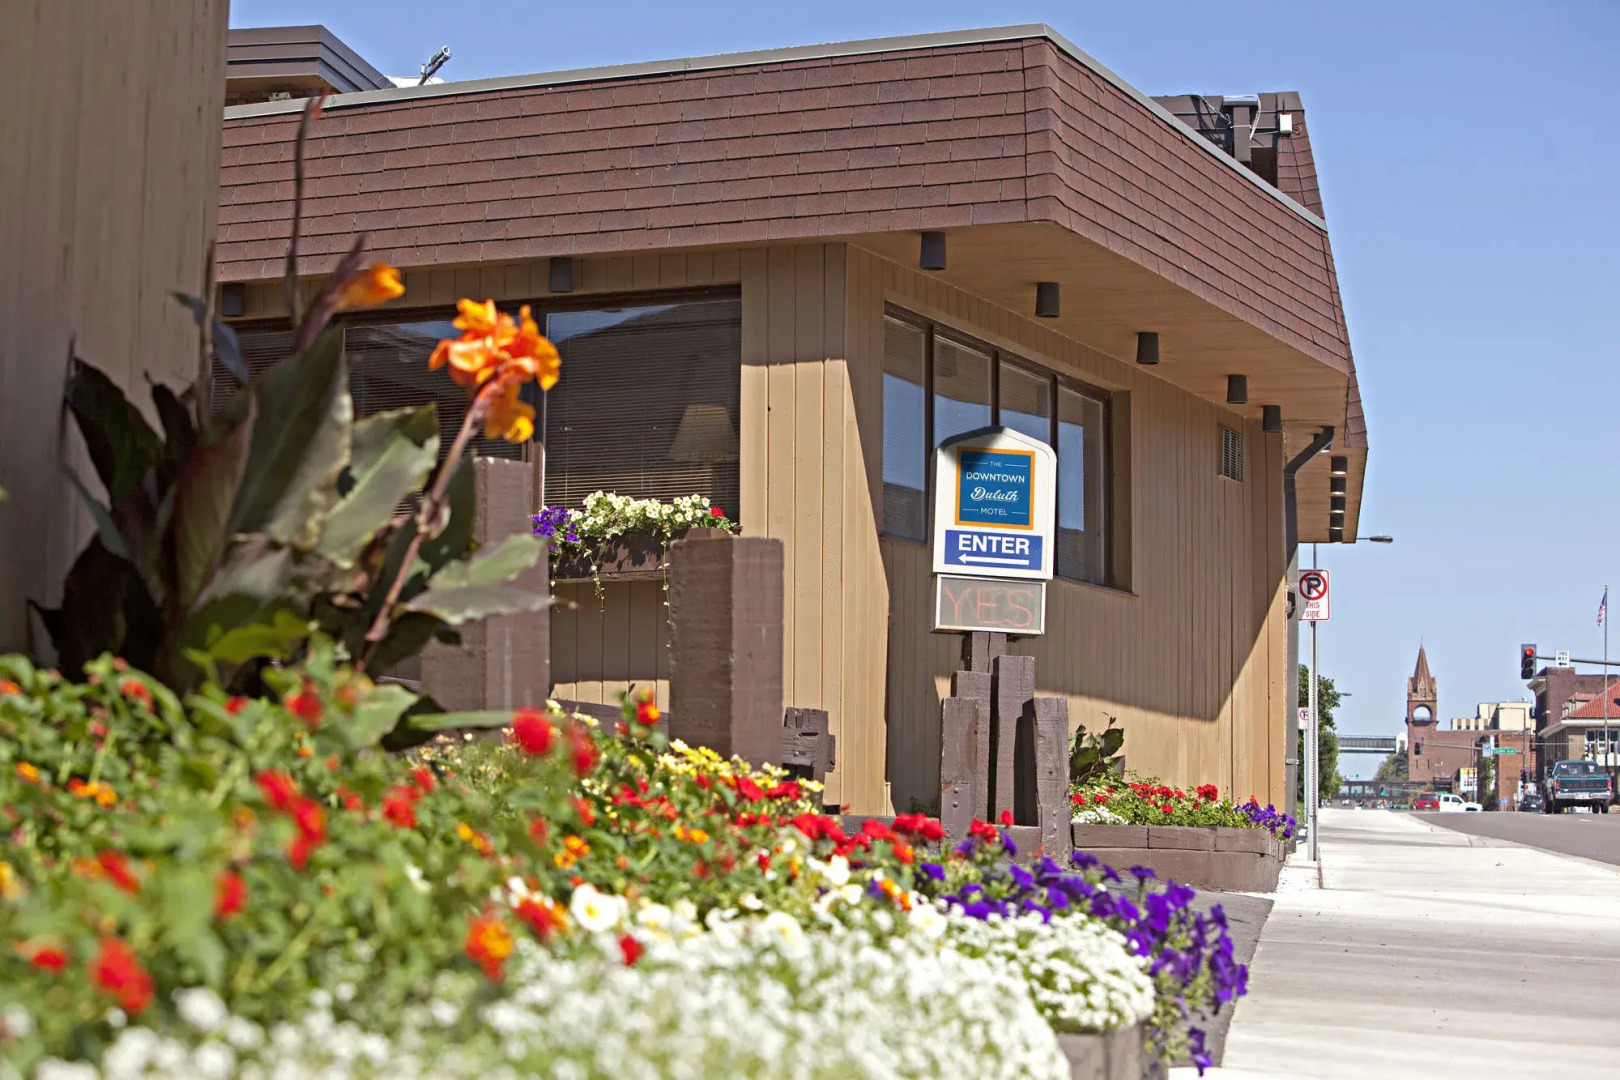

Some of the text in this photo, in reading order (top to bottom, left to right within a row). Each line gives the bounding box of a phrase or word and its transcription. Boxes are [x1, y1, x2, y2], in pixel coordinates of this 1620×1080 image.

[966, 471, 1025, 483] DOWNTOWN
[970, 487, 1019, 502] Duluth
[980, 507, 1008, 516] MOTEL
[958, 534, 1030, 555] ENTER
[944, 586, 1034, 627] YES
